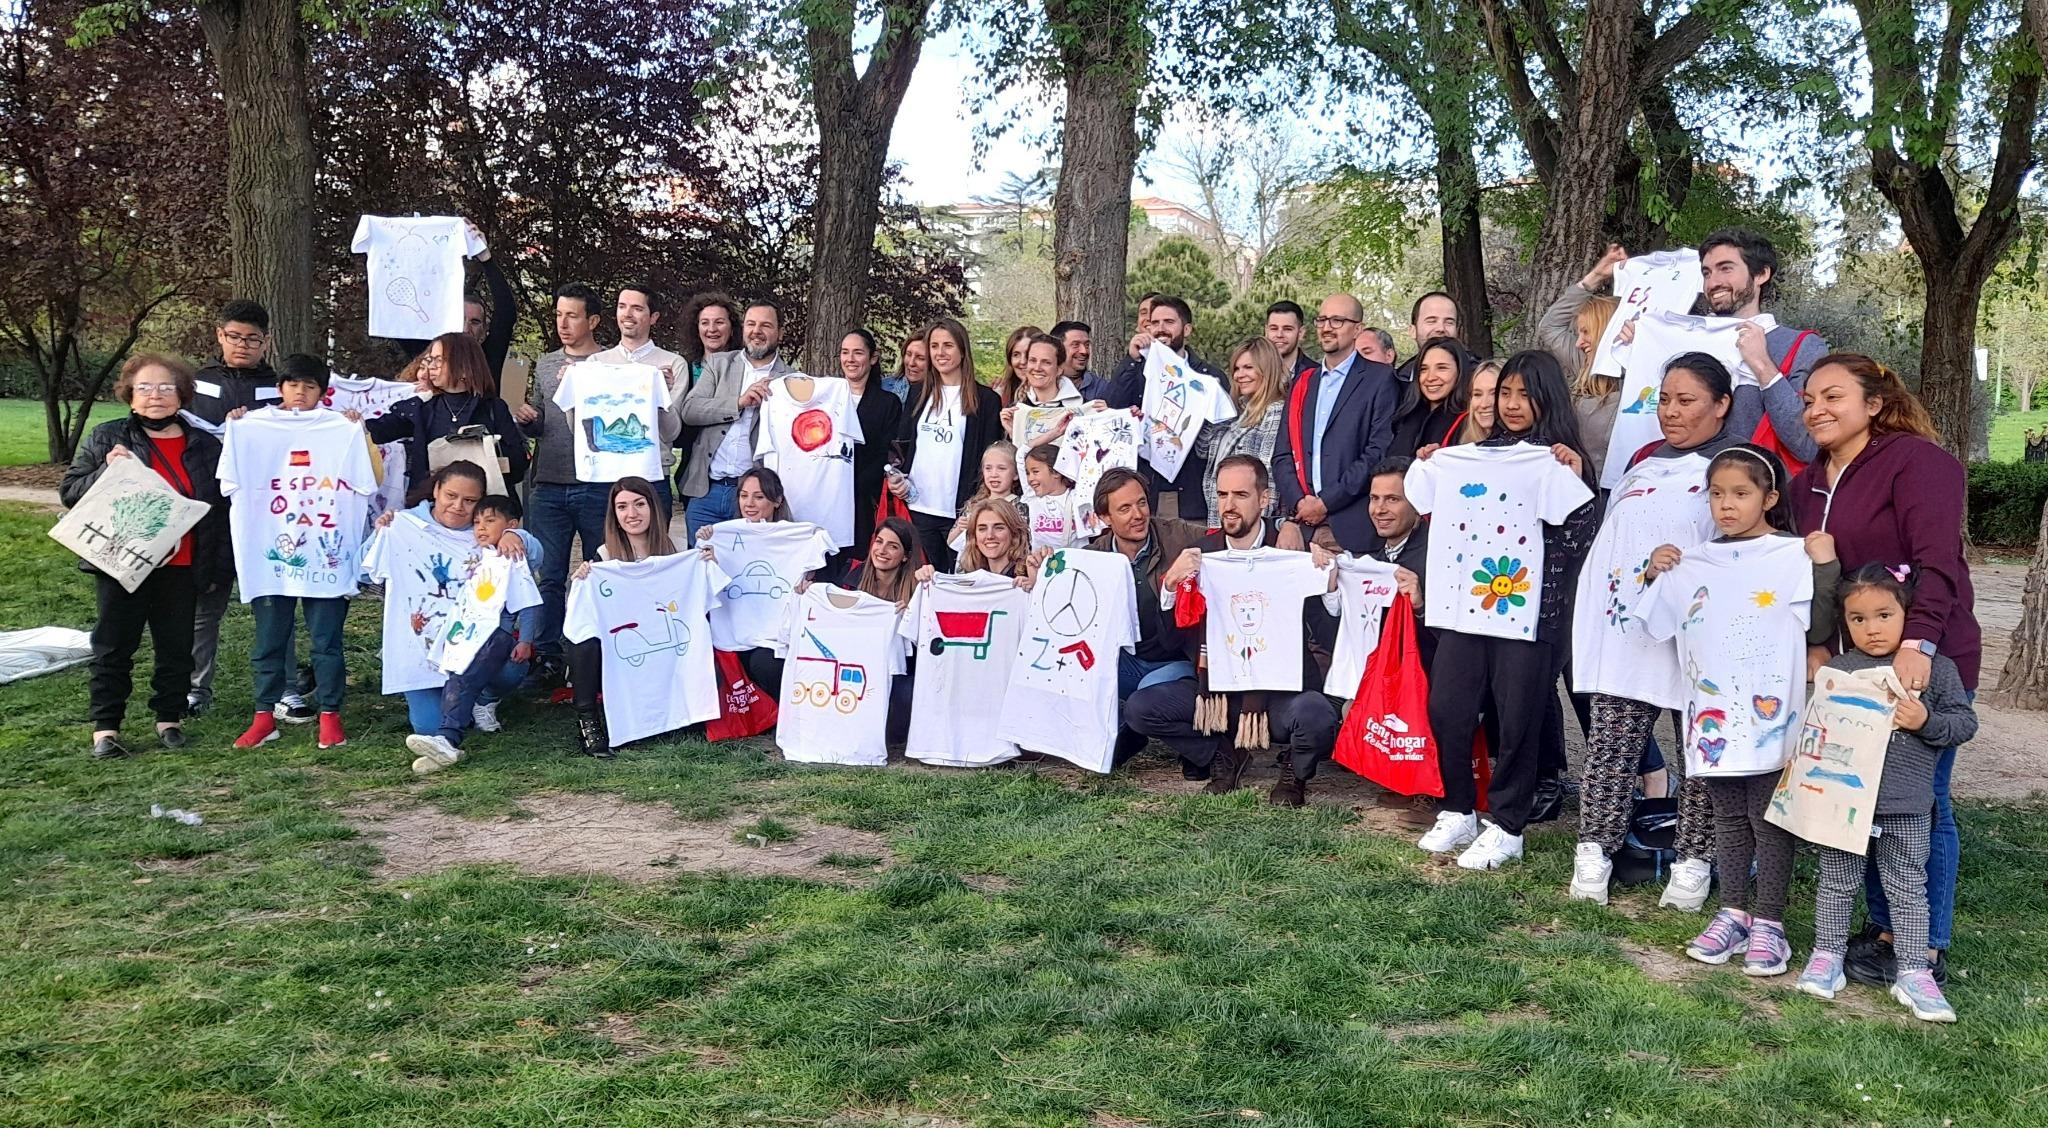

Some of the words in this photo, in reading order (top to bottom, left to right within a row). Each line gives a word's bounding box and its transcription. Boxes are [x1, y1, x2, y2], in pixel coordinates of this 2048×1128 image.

[286, 512, 337, 528] PAZ
[732, 532, 745, 552] A
[599, 579, 613, 598] G
[807, 607, 817, 621] L
[1389, 735, 1427, 753] hogar
